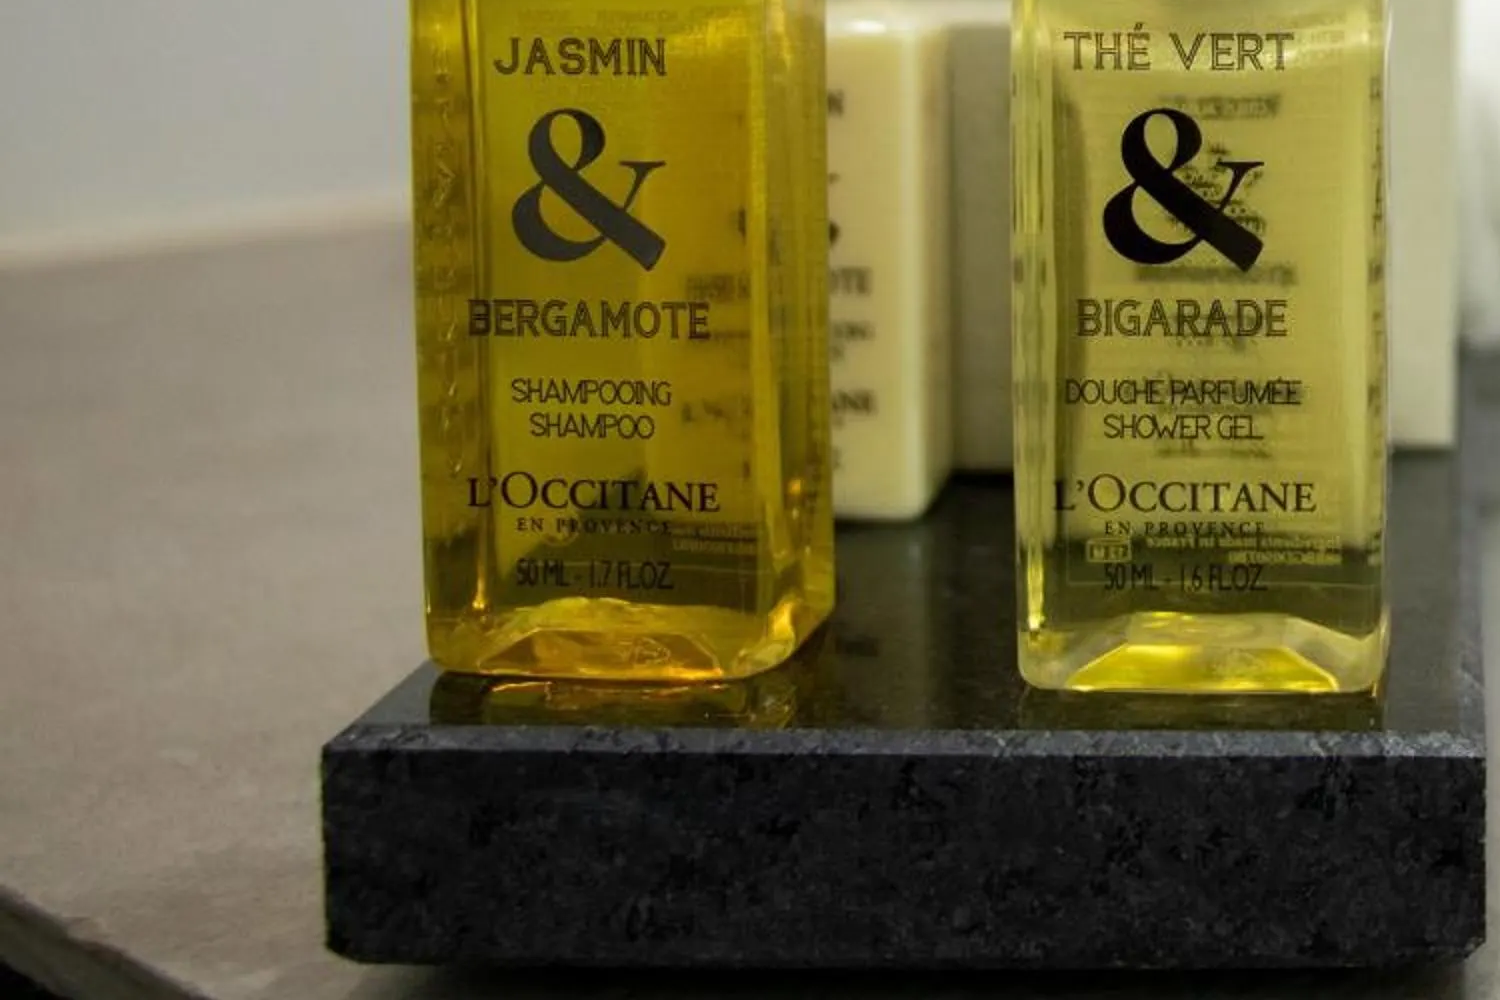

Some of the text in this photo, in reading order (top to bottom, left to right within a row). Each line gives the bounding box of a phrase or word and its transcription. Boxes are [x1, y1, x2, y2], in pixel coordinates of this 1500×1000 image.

[493, 36, 668, 77] JASMIN
[1063, 22, 1296, 72] THÉ VERT
[511, 107, 667, 272] &
[1102, 107, 1266, 273] &
[466, 298, 712, 341] BERGAMOTE
[1075, 298, 1289, 339] BIGARADE
[510, 378, 673, 407] SHAMPOOING
[1064, 377, 1304, 406] DOUCHE PARFUMÉE
[529, 413, 656, 441] SHAMPOO
[1103, 413, 1265, 442] SHOWER GEL
[466, 470, 722, 513] L'OCCITANE
[1052, 472, 1318, 514] L'OCCITANE
[516, 517, 675, 537] EN PROVENCE
[1104, 520, 1267, 538] EN PROVENCE
[515, 557, 540, 587] 50
[543, 558, 570, 588] ML
[1103, 563, 1127, 592] 50
[1130, 565, 1160, 592] ML
